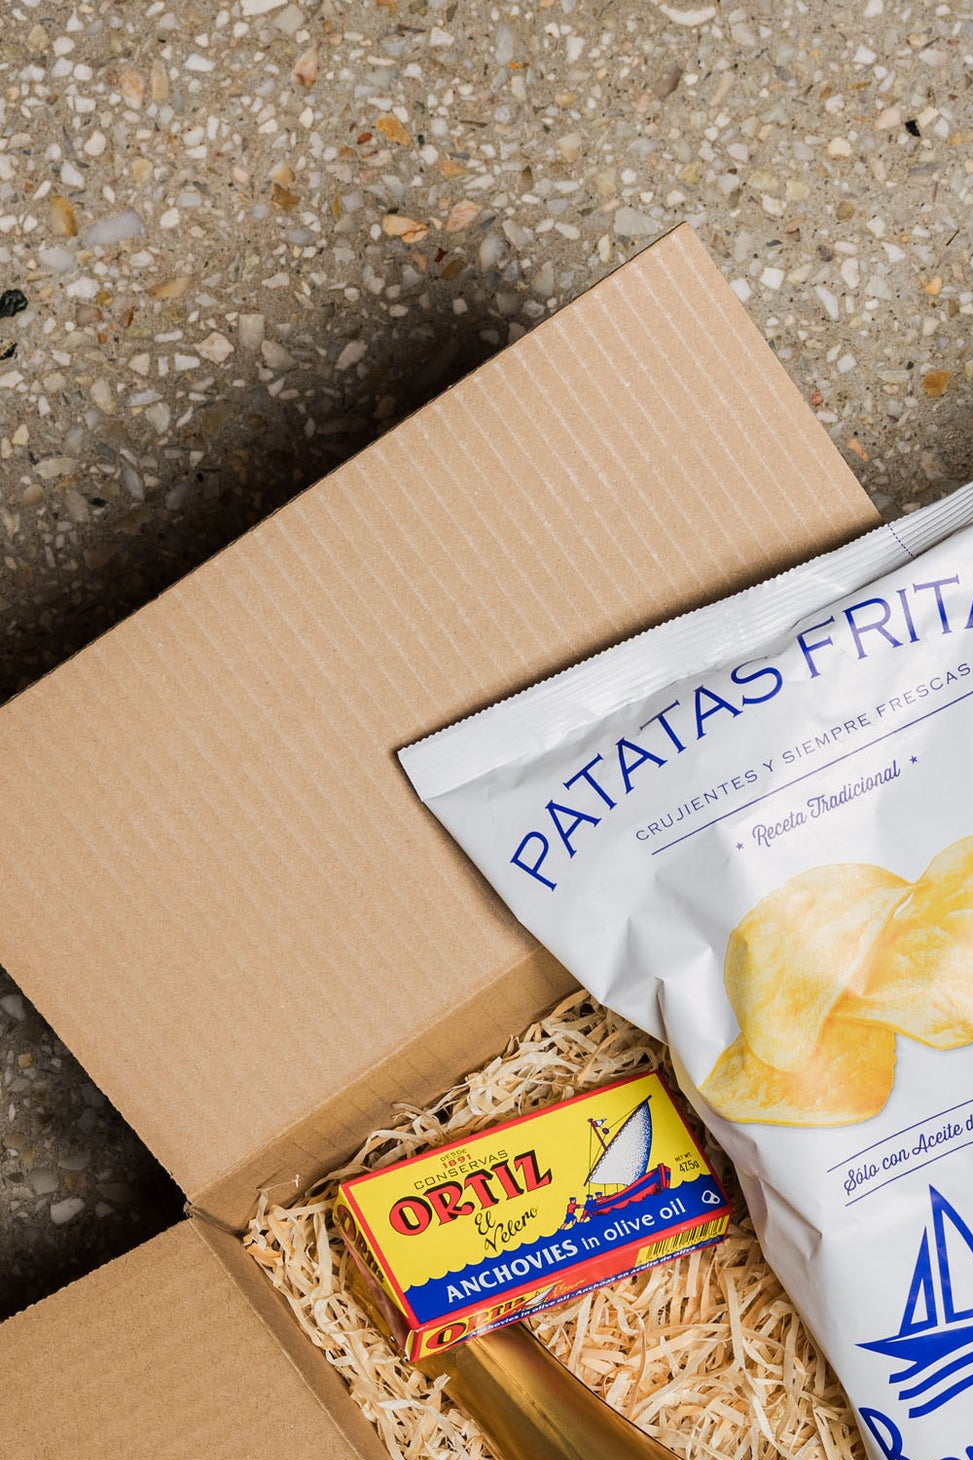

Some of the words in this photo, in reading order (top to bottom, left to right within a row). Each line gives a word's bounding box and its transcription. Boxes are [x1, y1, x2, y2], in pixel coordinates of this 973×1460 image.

[510, 655, 783, 892] PATATAS
[635, 769, 758, 841] CRUJIENTES
[762, 760, 775, 772] Y
[781, 713, 871, 764] SIEMPRE
[876, 662, 972, 718] FRESCAS
[752, 806, 808, 848] Receta
[807, 760, 901, 818] Tradicional
[389, 1149, 553, 1236] ORTIZ
[413, 1150, 508, 1190] CONSERVAS
[440, 1149, 467, 1161] DESDE
[442, 1154, 472, 1169] 1891
[843, 1163, 879, 1195] Sólo
[882, 1148, 910, 1170] con
[911, 1123, 963, 1155] Aceite
[447, 1240, 578, 1303] ANCHOVIES
[581, 1236, 600, 1250] in
[604, 1214, 655, 1241] olive
[659, 1197, 687, 1220] oil
[474, 1211, 495, 1235] El
[484, 1206, 538, 1252] Velero
[469, 1313, 519, 1336] Anchovies
[521, 1309, 530, 1317] in
[531, 1299, 555, 1312] olive
[556, 1294, 570, 1303] oil
[575, 1277, 616, 1296] Anchoas
[617, 1271, 629, 1279] en
[630, 1260, 659, 1274] aceite
[660, 1254, 672, 1262] de
[673, 1246, 696, 1257] oliva
